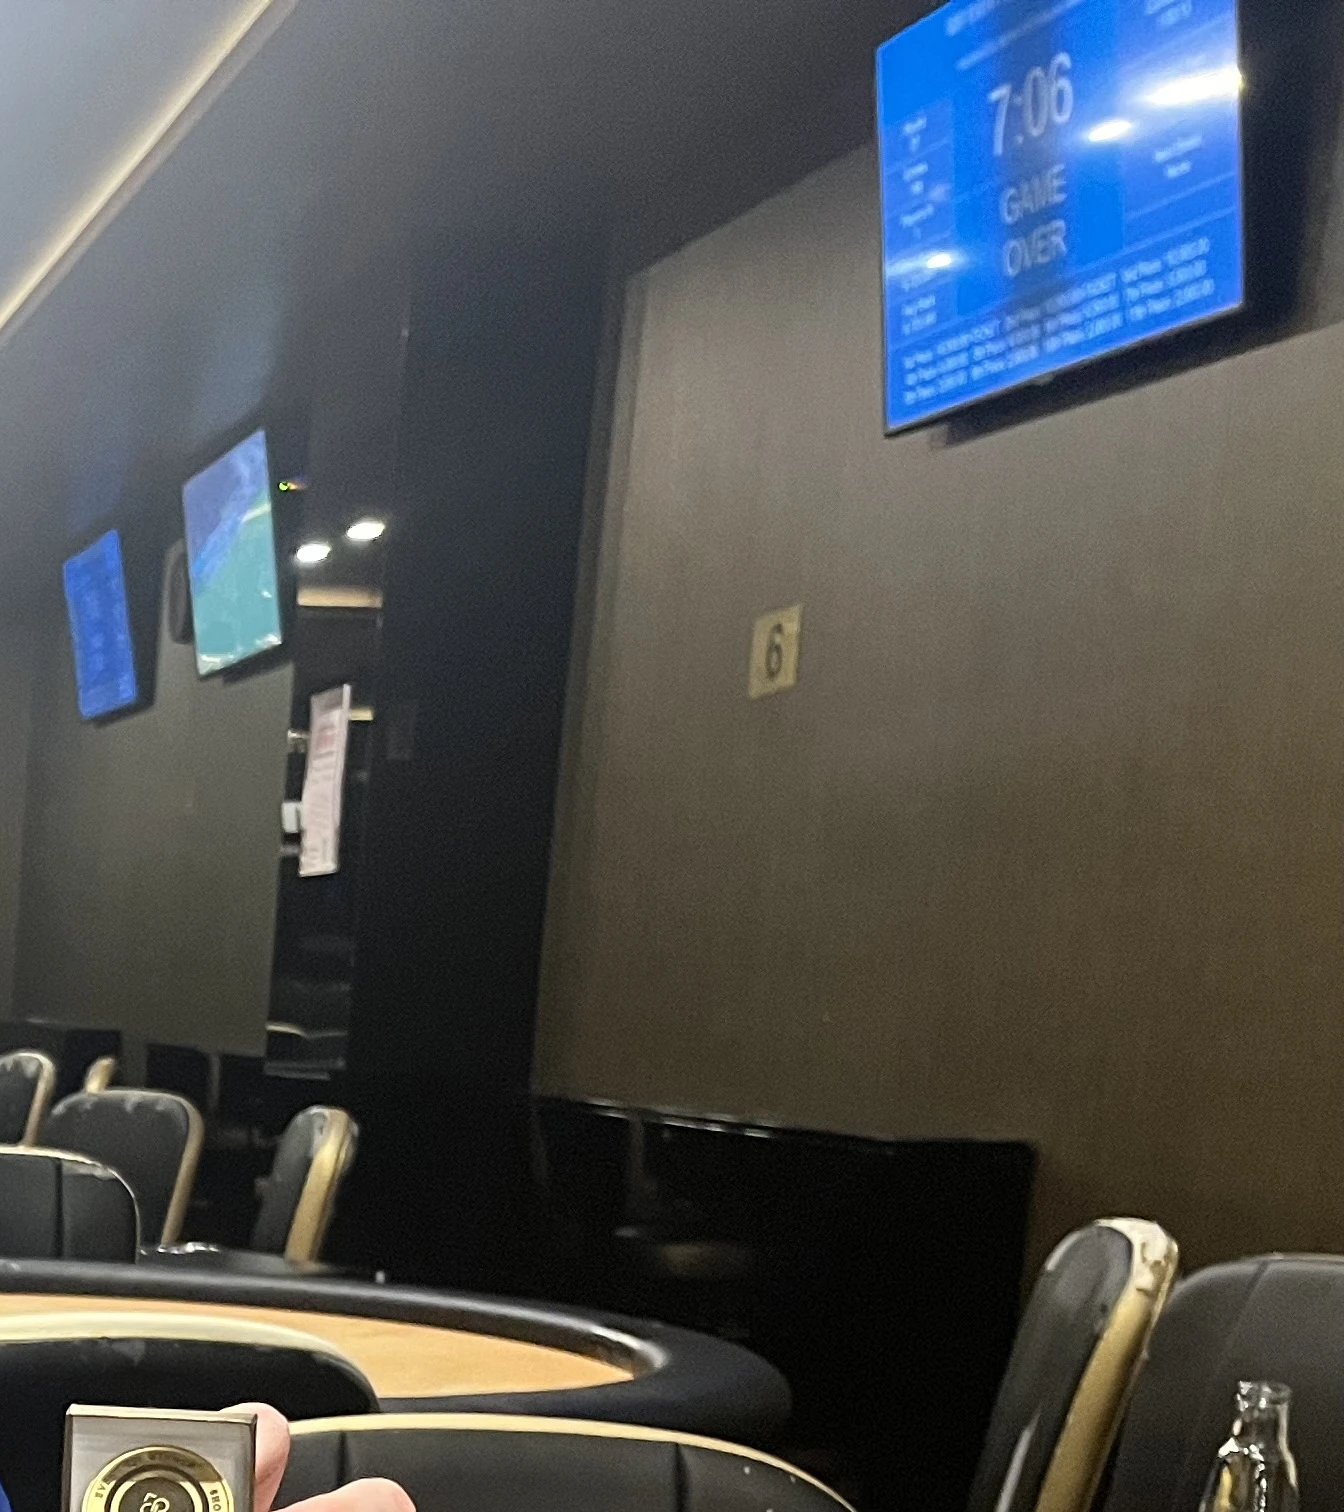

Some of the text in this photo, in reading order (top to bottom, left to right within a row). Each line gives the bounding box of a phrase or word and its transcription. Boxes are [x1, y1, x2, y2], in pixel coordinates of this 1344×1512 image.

[988, 51, 1074, 156] 7:06
[1000, 164, 1067, 225] GAME
[1002, 219, 1067, 277] OVER
[765, 623, 783, 681] 6
